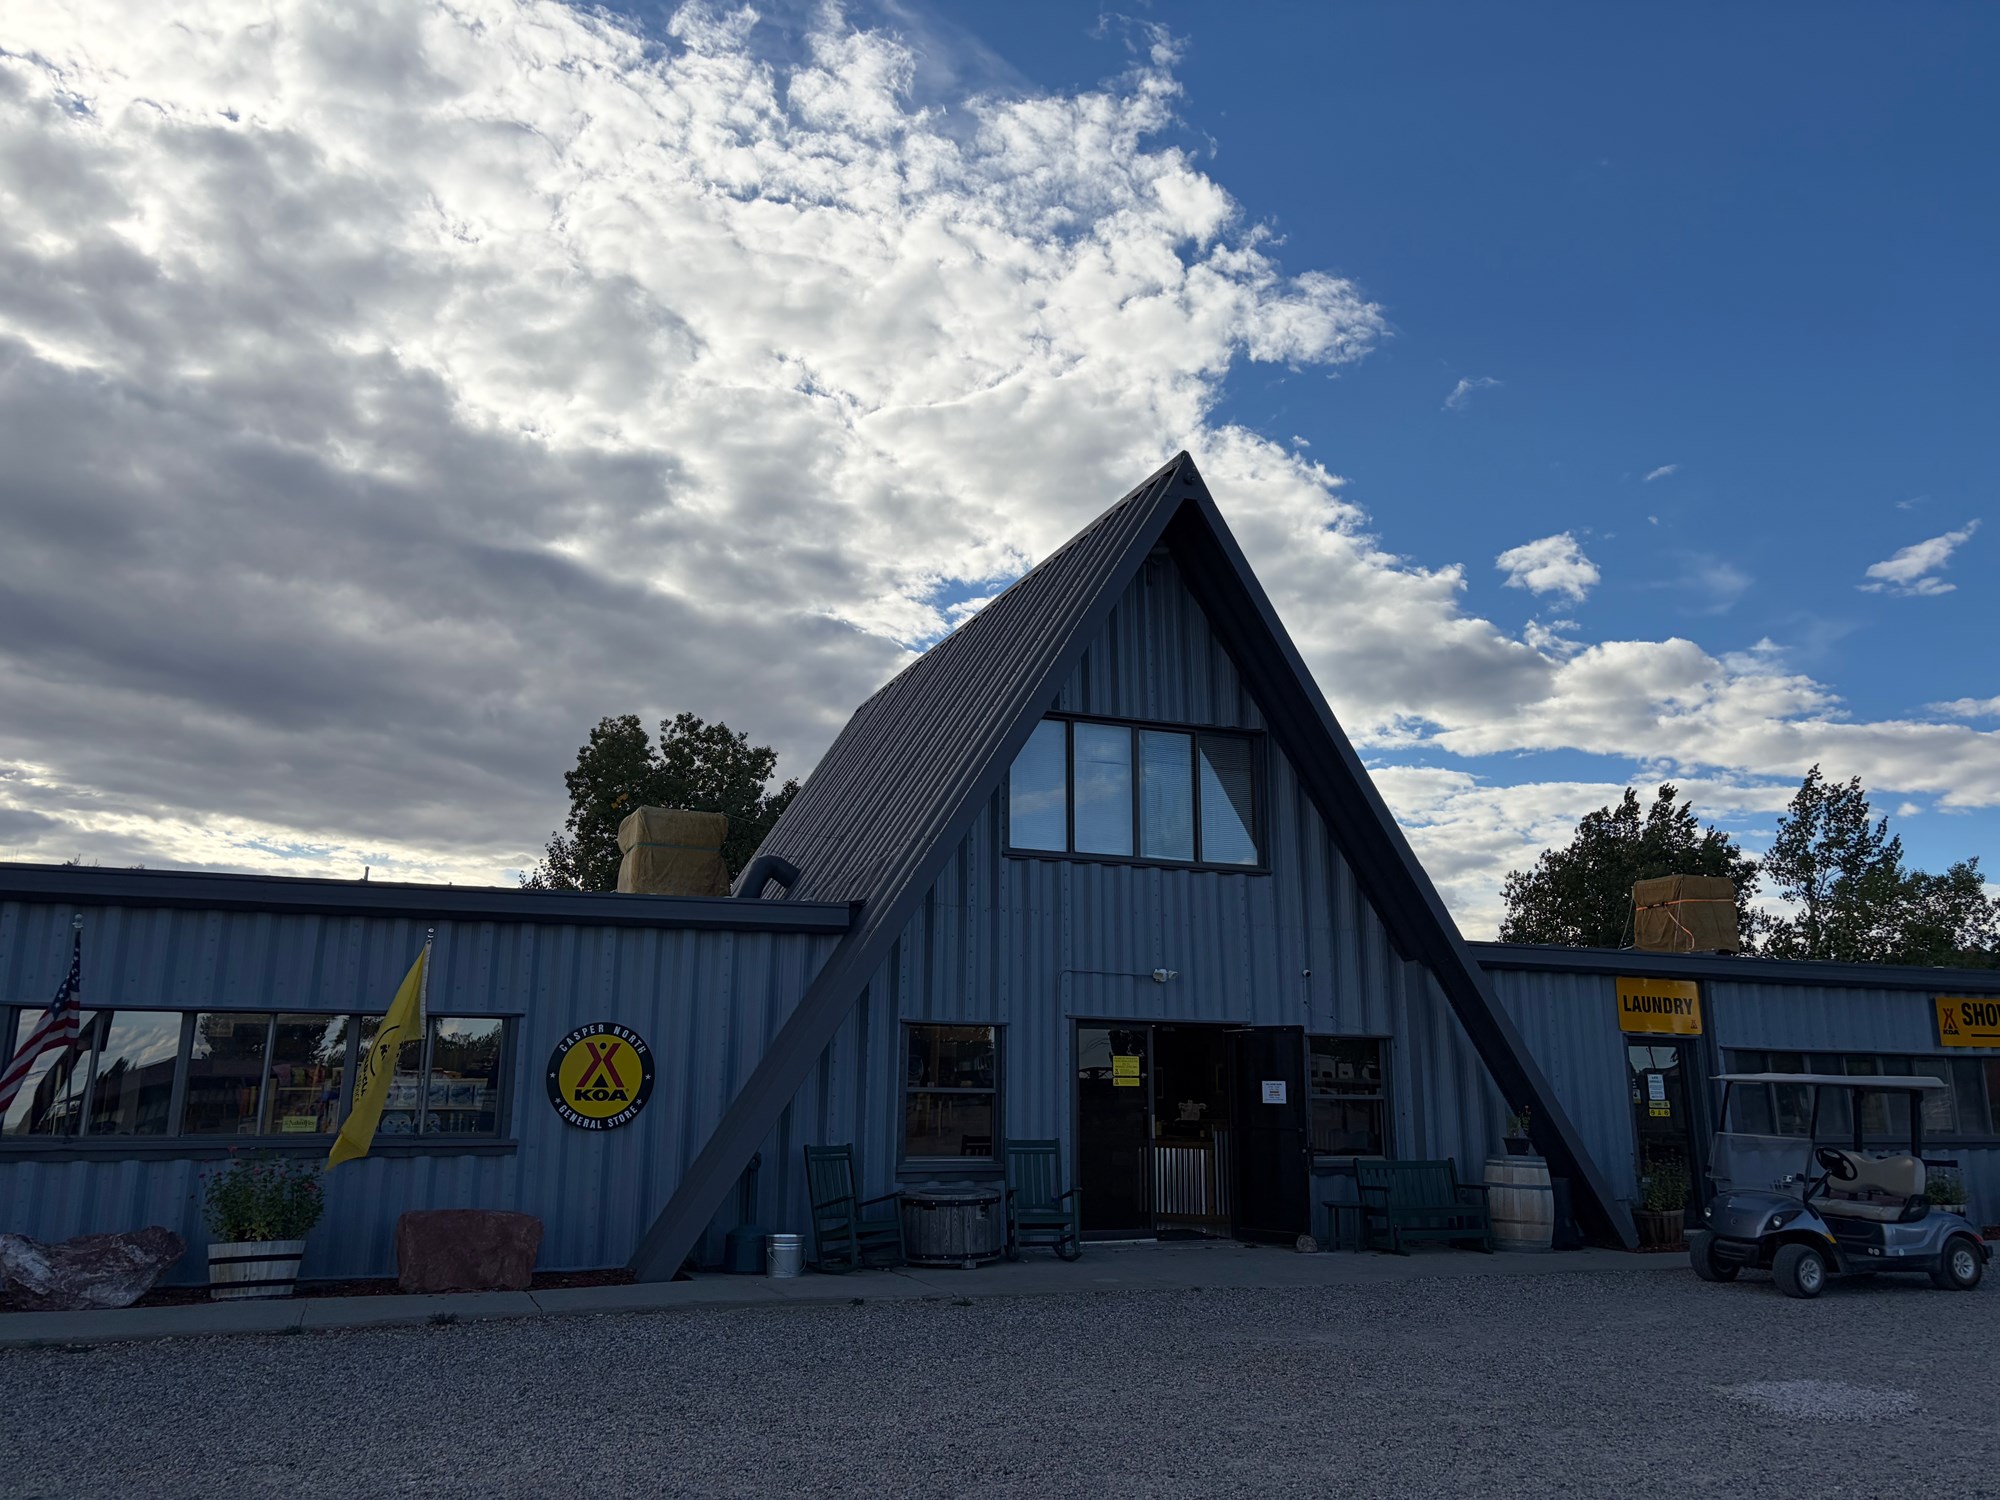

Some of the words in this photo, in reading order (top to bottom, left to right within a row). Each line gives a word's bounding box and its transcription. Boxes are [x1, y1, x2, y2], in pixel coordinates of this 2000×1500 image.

[1623, 995, 1693, 1015] LAUNDRY
[1961, 1003, 2000, 1026] SHO
[558, 1024, 604, 1052] CASPER
[613, 1025, 647, 1054] NORTH
[574, 1089, 629, 1101] KOA
[558, 1104, 602, 1129] GENERAL
[607, 1105, 638, 1127] STORE
